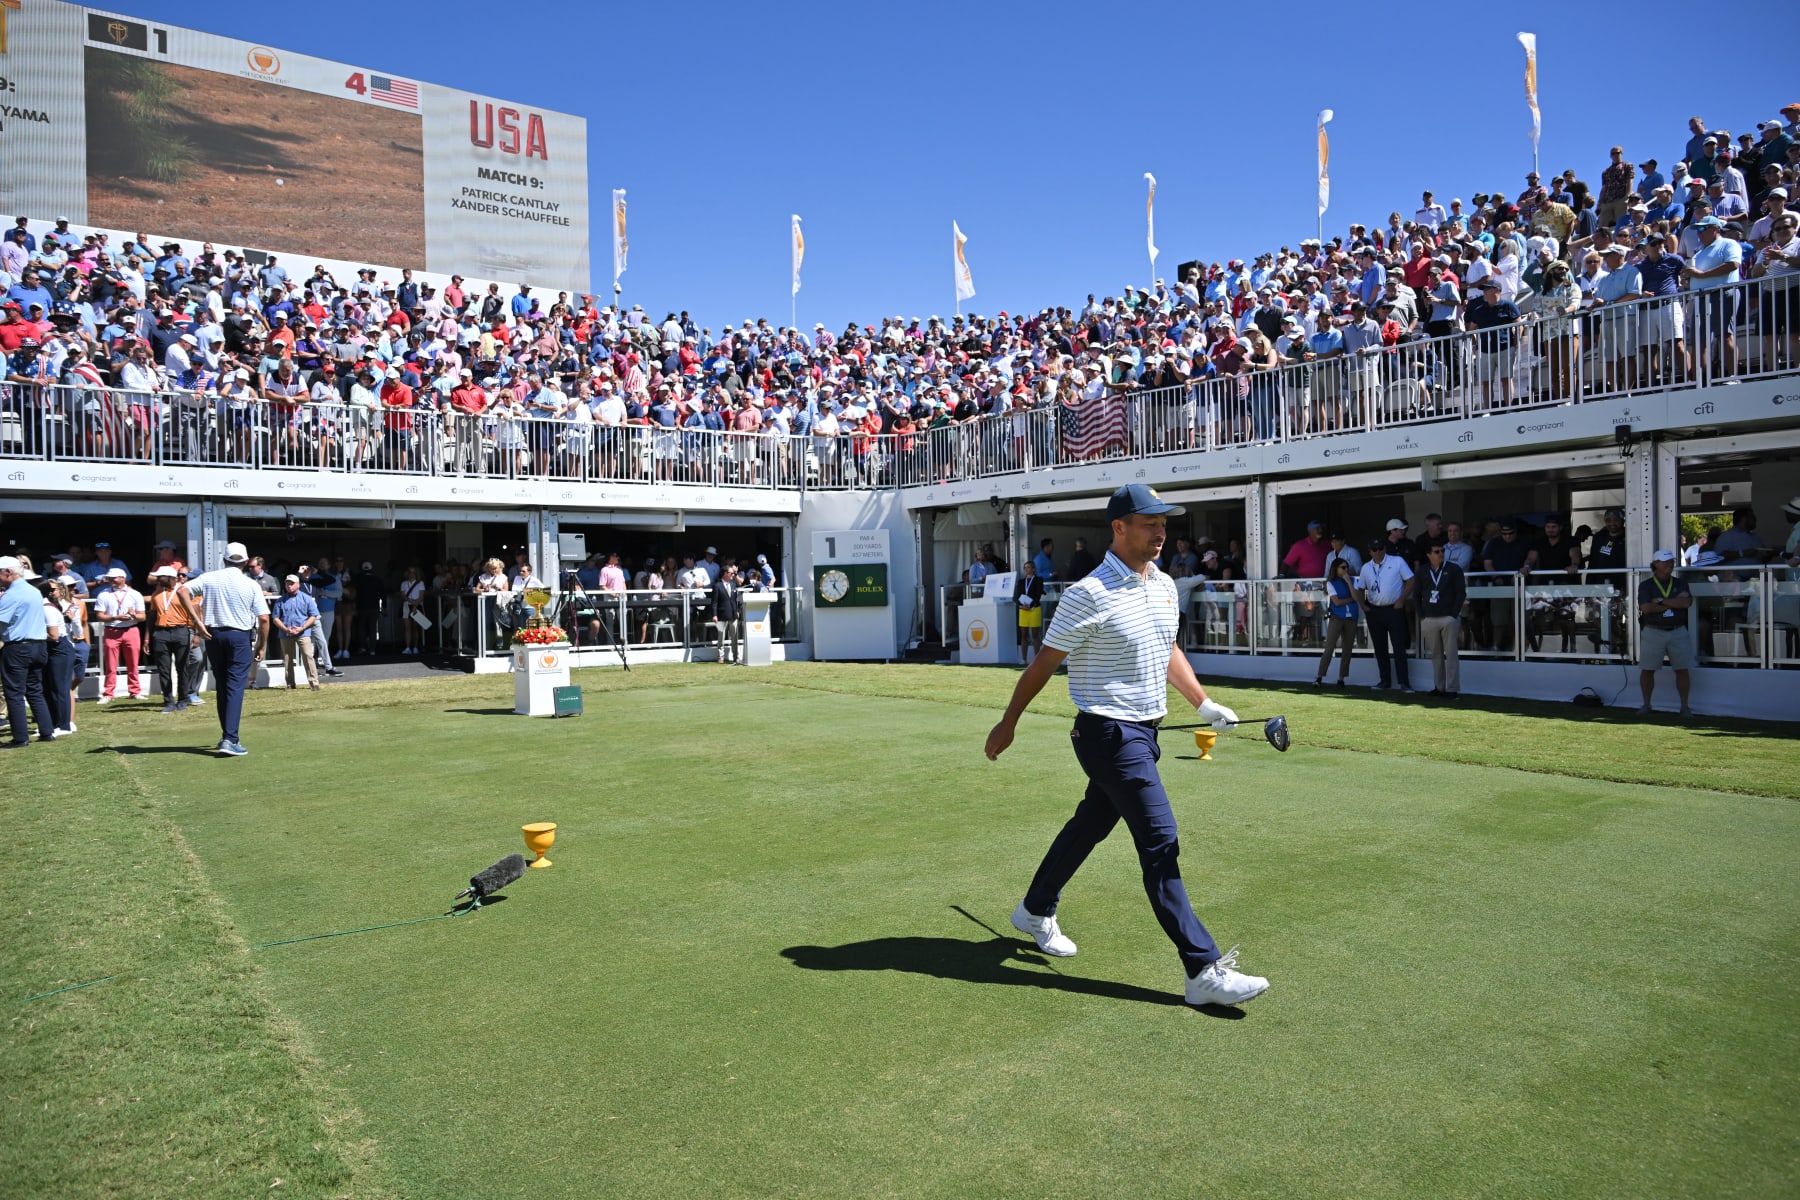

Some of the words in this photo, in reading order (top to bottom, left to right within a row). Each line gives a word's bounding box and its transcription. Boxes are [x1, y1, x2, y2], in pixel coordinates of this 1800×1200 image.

[153, 28, 167, 54] 1
[345, 72, 367, 95] 4
[470, 100, 548, 160] USA
[478, 167, 527, 186] MATCH
[530, 177, 544, 189] 9:
[462, 186, 507, 203] PATRICK
[510, 196, 560, 212] CANTLAY
[451, 198, 499, 215] XANDER
[502, 207, 570, 226] SCHAUFFELE
[1694, 402, 1714, 415] citi
[1527, 421, 1564, 432] cognizant
[1612, 415, 1641, 424] ROLEX
[1458, 431, 1473, 442] citi
[8, 471, 24, 480] citi
[224, 480, 238, 488] citi
[825, 537, 836, 558] 1
